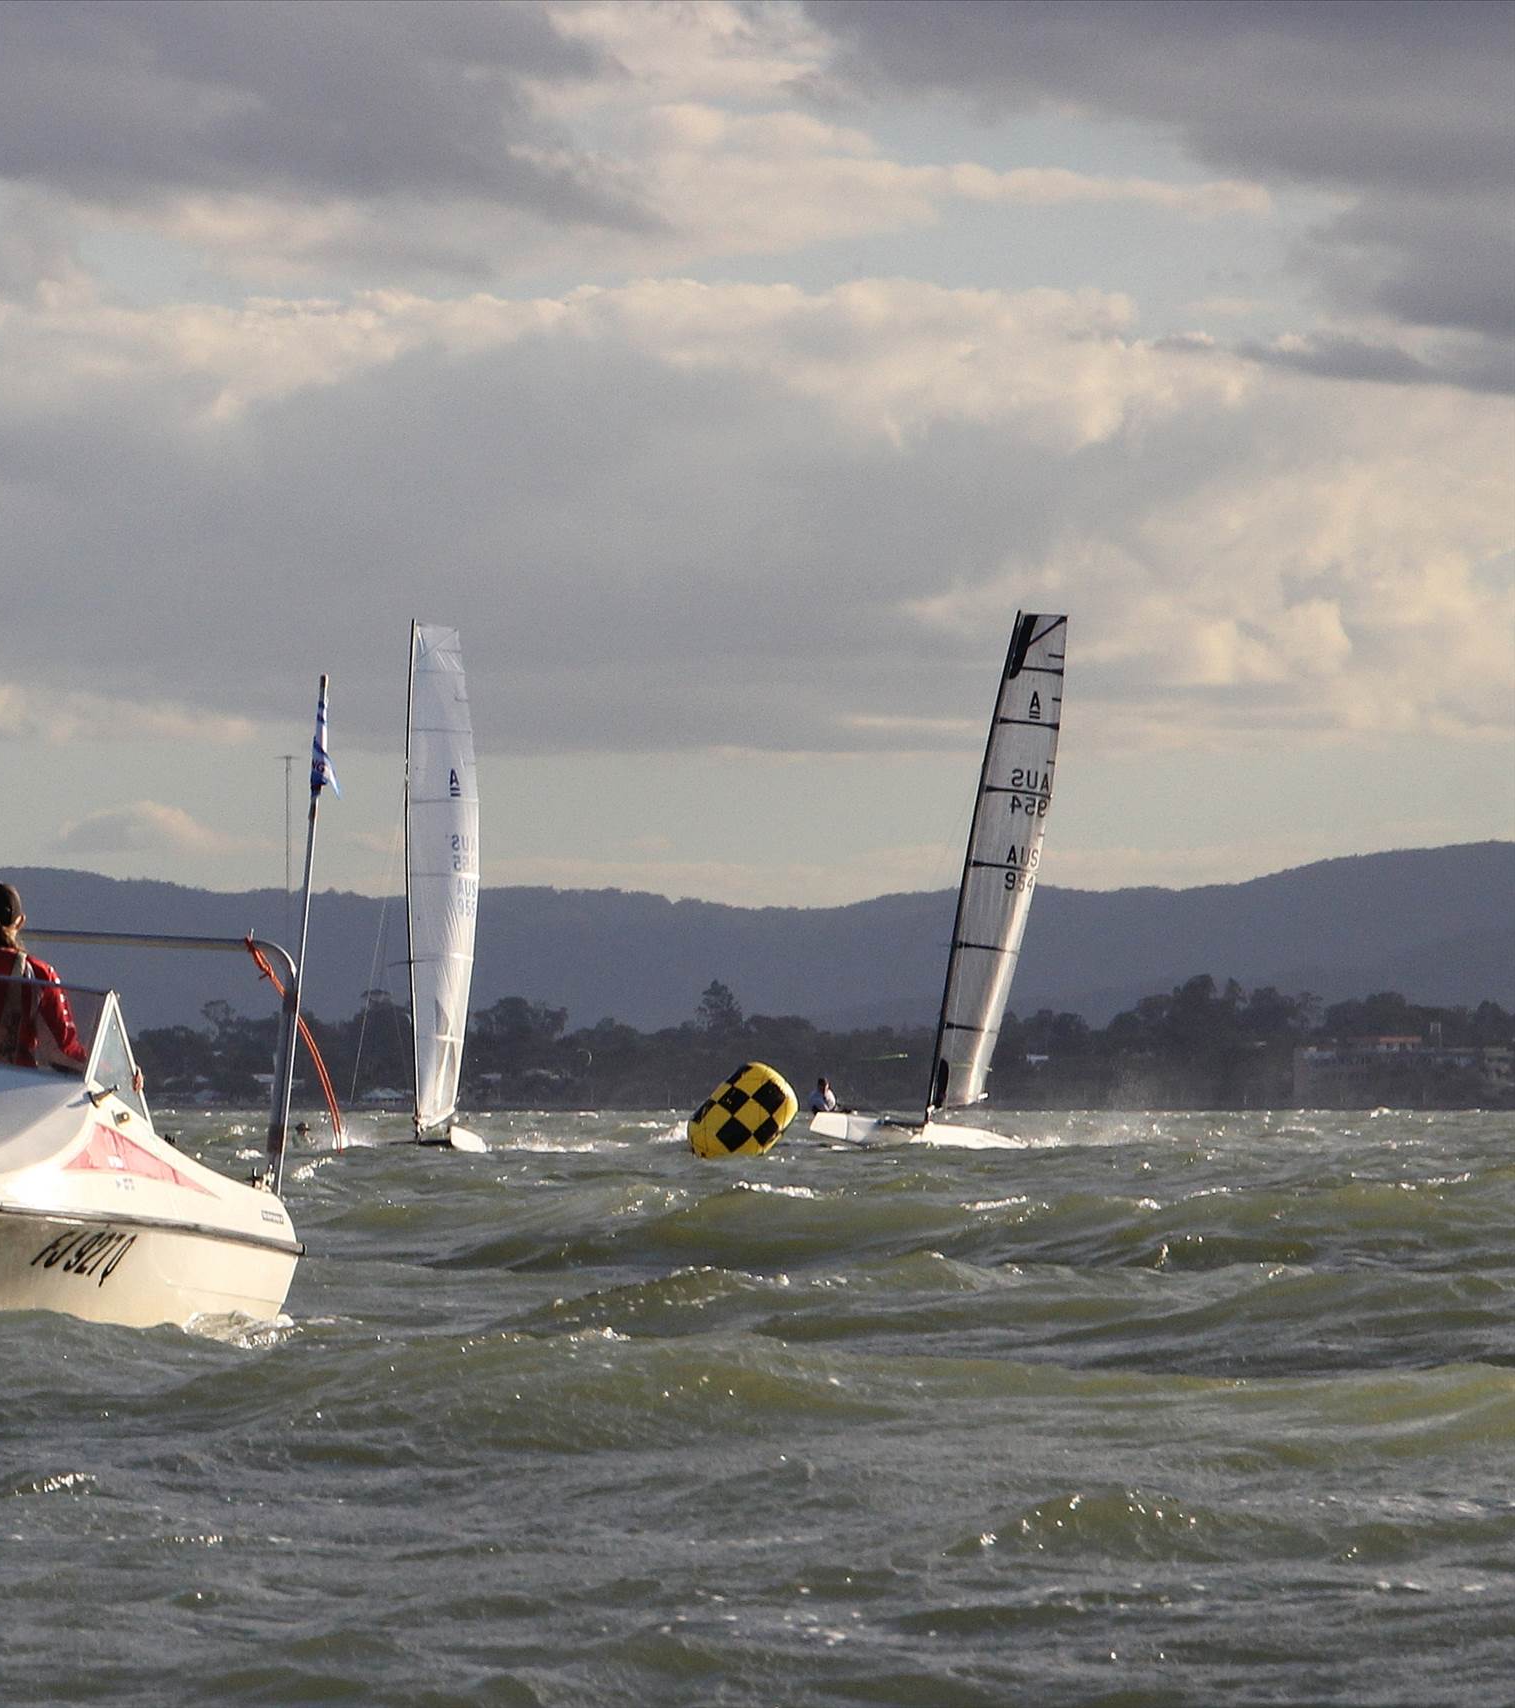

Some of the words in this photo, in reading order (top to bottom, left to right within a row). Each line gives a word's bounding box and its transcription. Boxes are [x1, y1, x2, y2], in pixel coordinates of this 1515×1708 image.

[1030, 691, 1041, 710] A
[449, 768, 460, 786] A
[1007, 845, 1039, 867] AUS
[1005, 871, 1034, 892] 954
